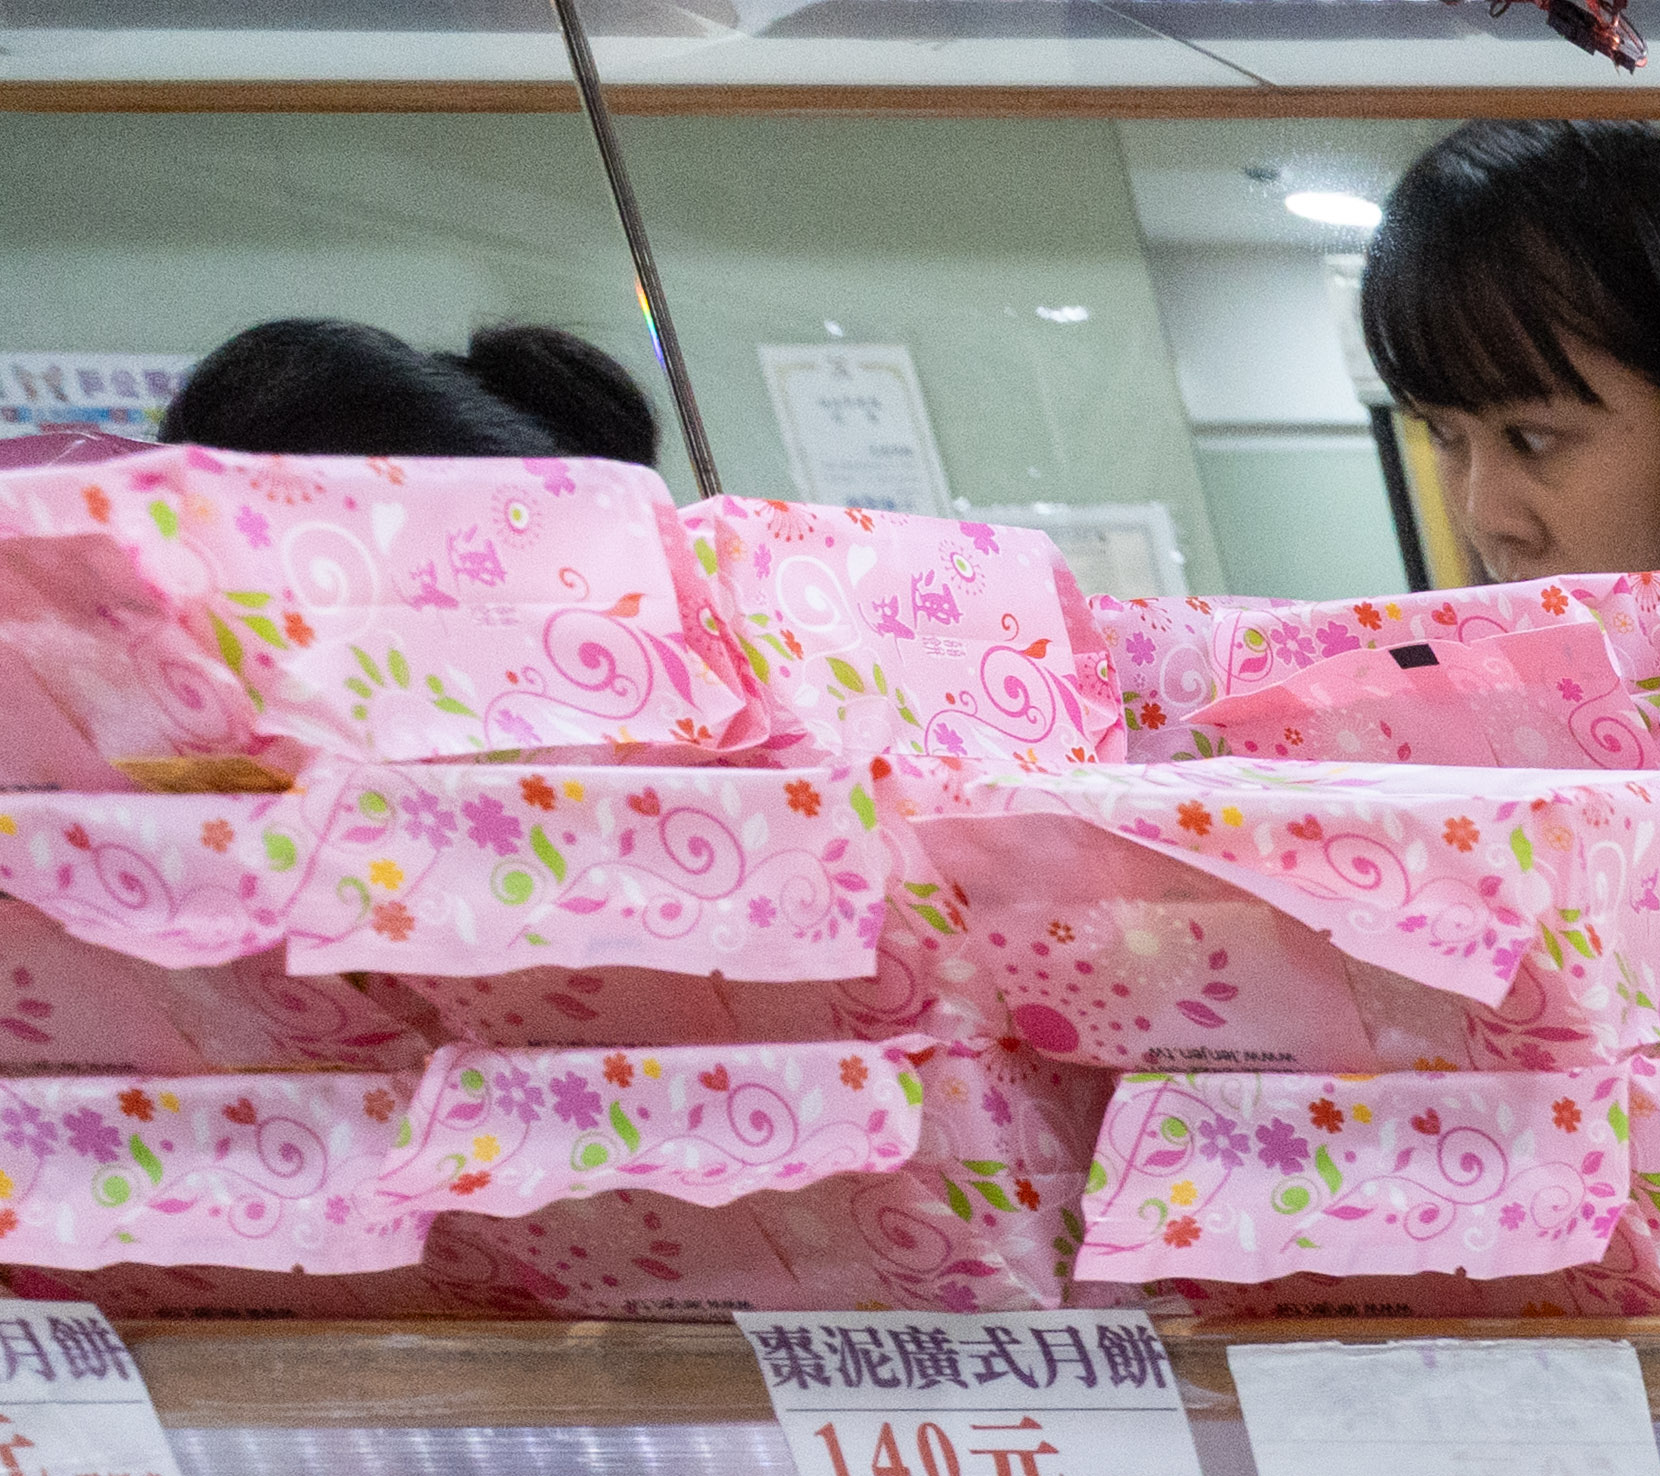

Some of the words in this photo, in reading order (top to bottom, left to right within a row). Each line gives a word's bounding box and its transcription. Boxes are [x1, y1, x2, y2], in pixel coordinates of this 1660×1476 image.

[750, 1324, 1168, 1390] 棗泥廣式月餅
